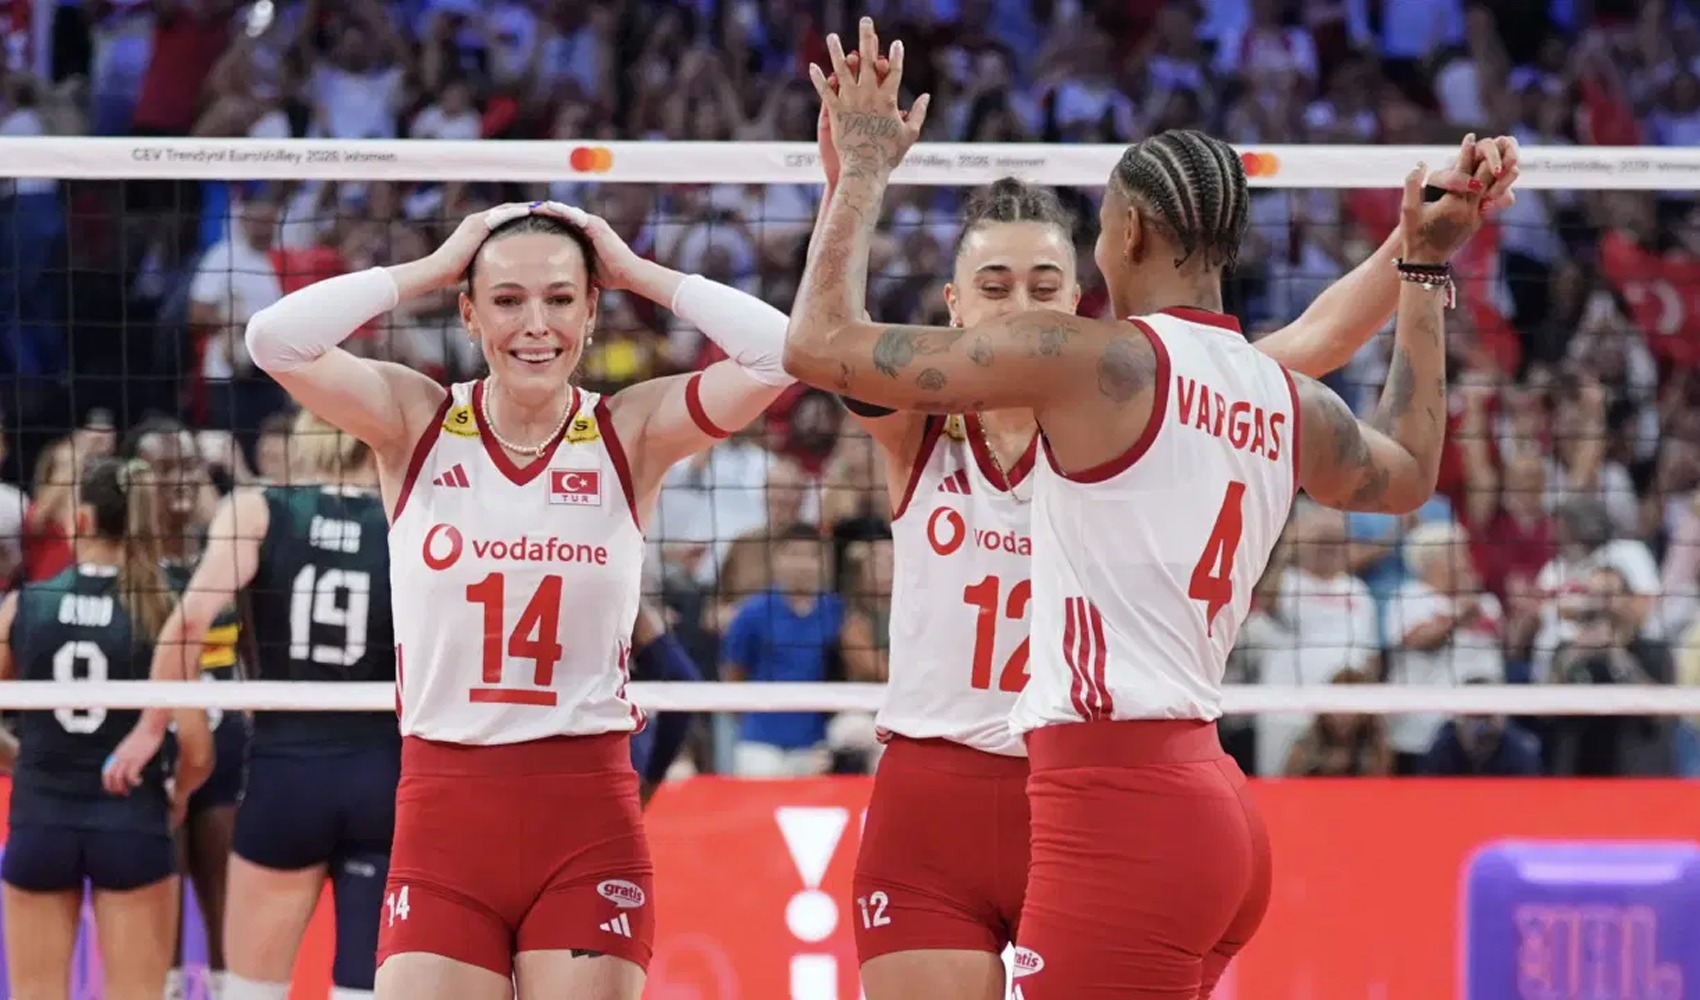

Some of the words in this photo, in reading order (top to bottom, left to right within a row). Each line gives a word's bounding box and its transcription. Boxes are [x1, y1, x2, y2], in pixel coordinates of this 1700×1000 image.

[131, 148, 161, 161] CEV
[455, 410, 469, 425] S
[574, 420, 588, 432] S
[1177, 376, 1286, 461] VARGAS
[562, 494, 590, 504] TUR
[472, 536, 607, 565] vodafone
[974, 528, 1031, 556] voda
[1188, 480, 1246, 638] 4
[289, 563, 371, 667] 19
[466, 572, 563, 687] 14
[963, 575, 1031, 692] 12
[386, 884, 411, 928] 14
[603, 883, 642, 901] gratis
[857, 890, 891, 929] 12
